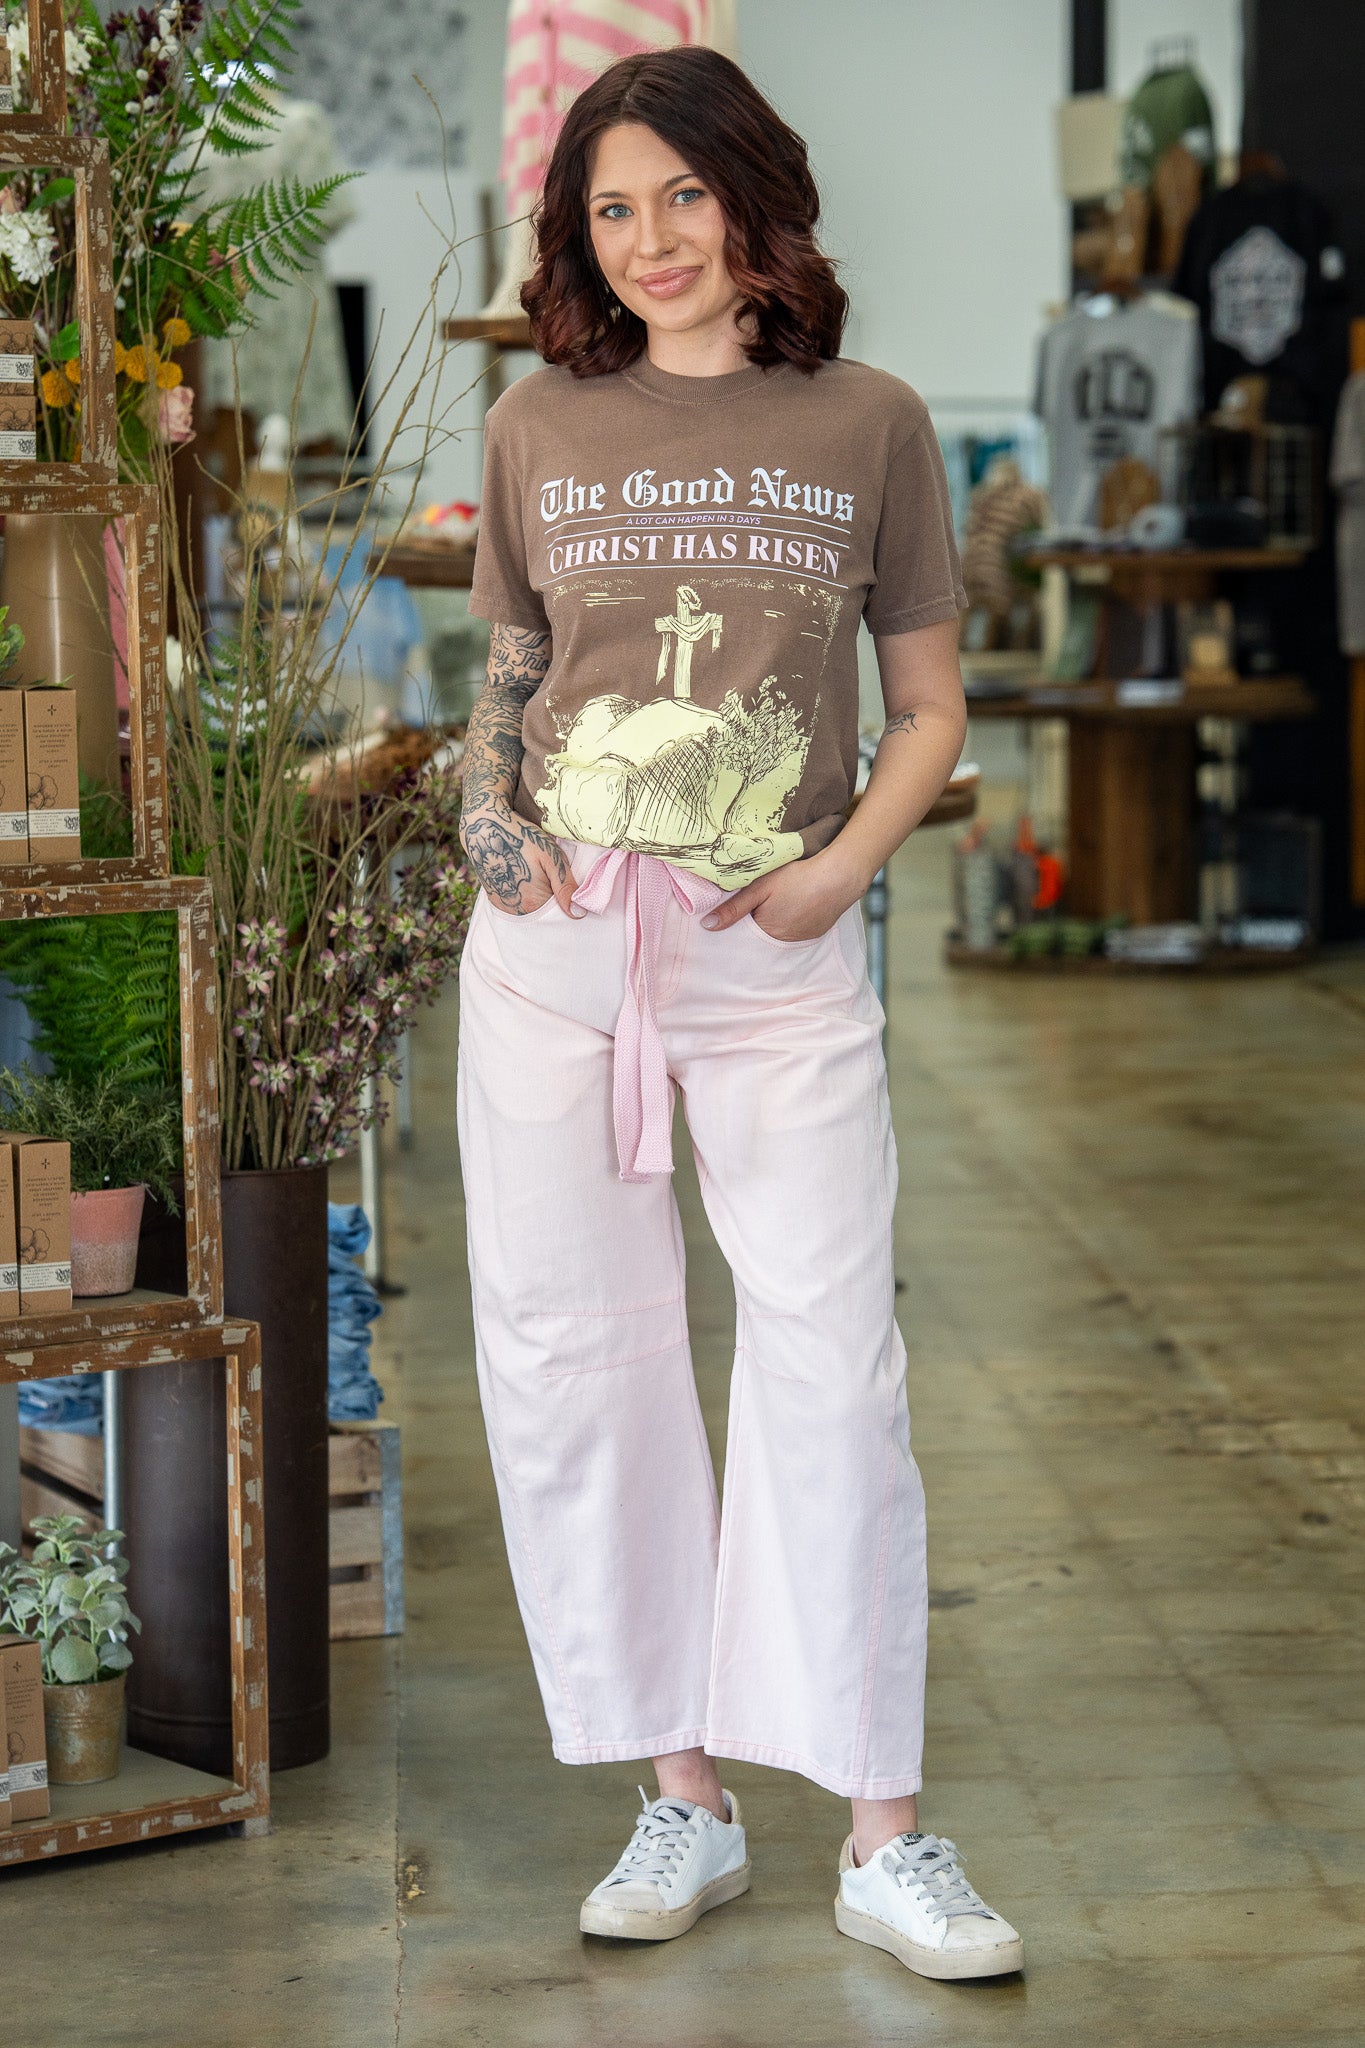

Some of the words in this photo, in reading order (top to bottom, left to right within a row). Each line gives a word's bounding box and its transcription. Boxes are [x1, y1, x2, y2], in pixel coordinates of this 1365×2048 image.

[540, 475, 606, 522] The
[622, 467, 735, 508] Good
[748, 467, 855, 522] News
[626, 517, 633, 525] A
[635, 516, 653, 525] LOT
[655, 515, 676, 525] CAN
[677, 514, 715, 524] HAPPEN
[717, 514, 727, 523] IN
[728, 514, 735, 523] 3
[736, 515, 761, 525] DAYS
[549, 535, 664, 575] CHRIST
[671, 533, 737, 560] HAS
[746, 535, 840, 579] RISEN
